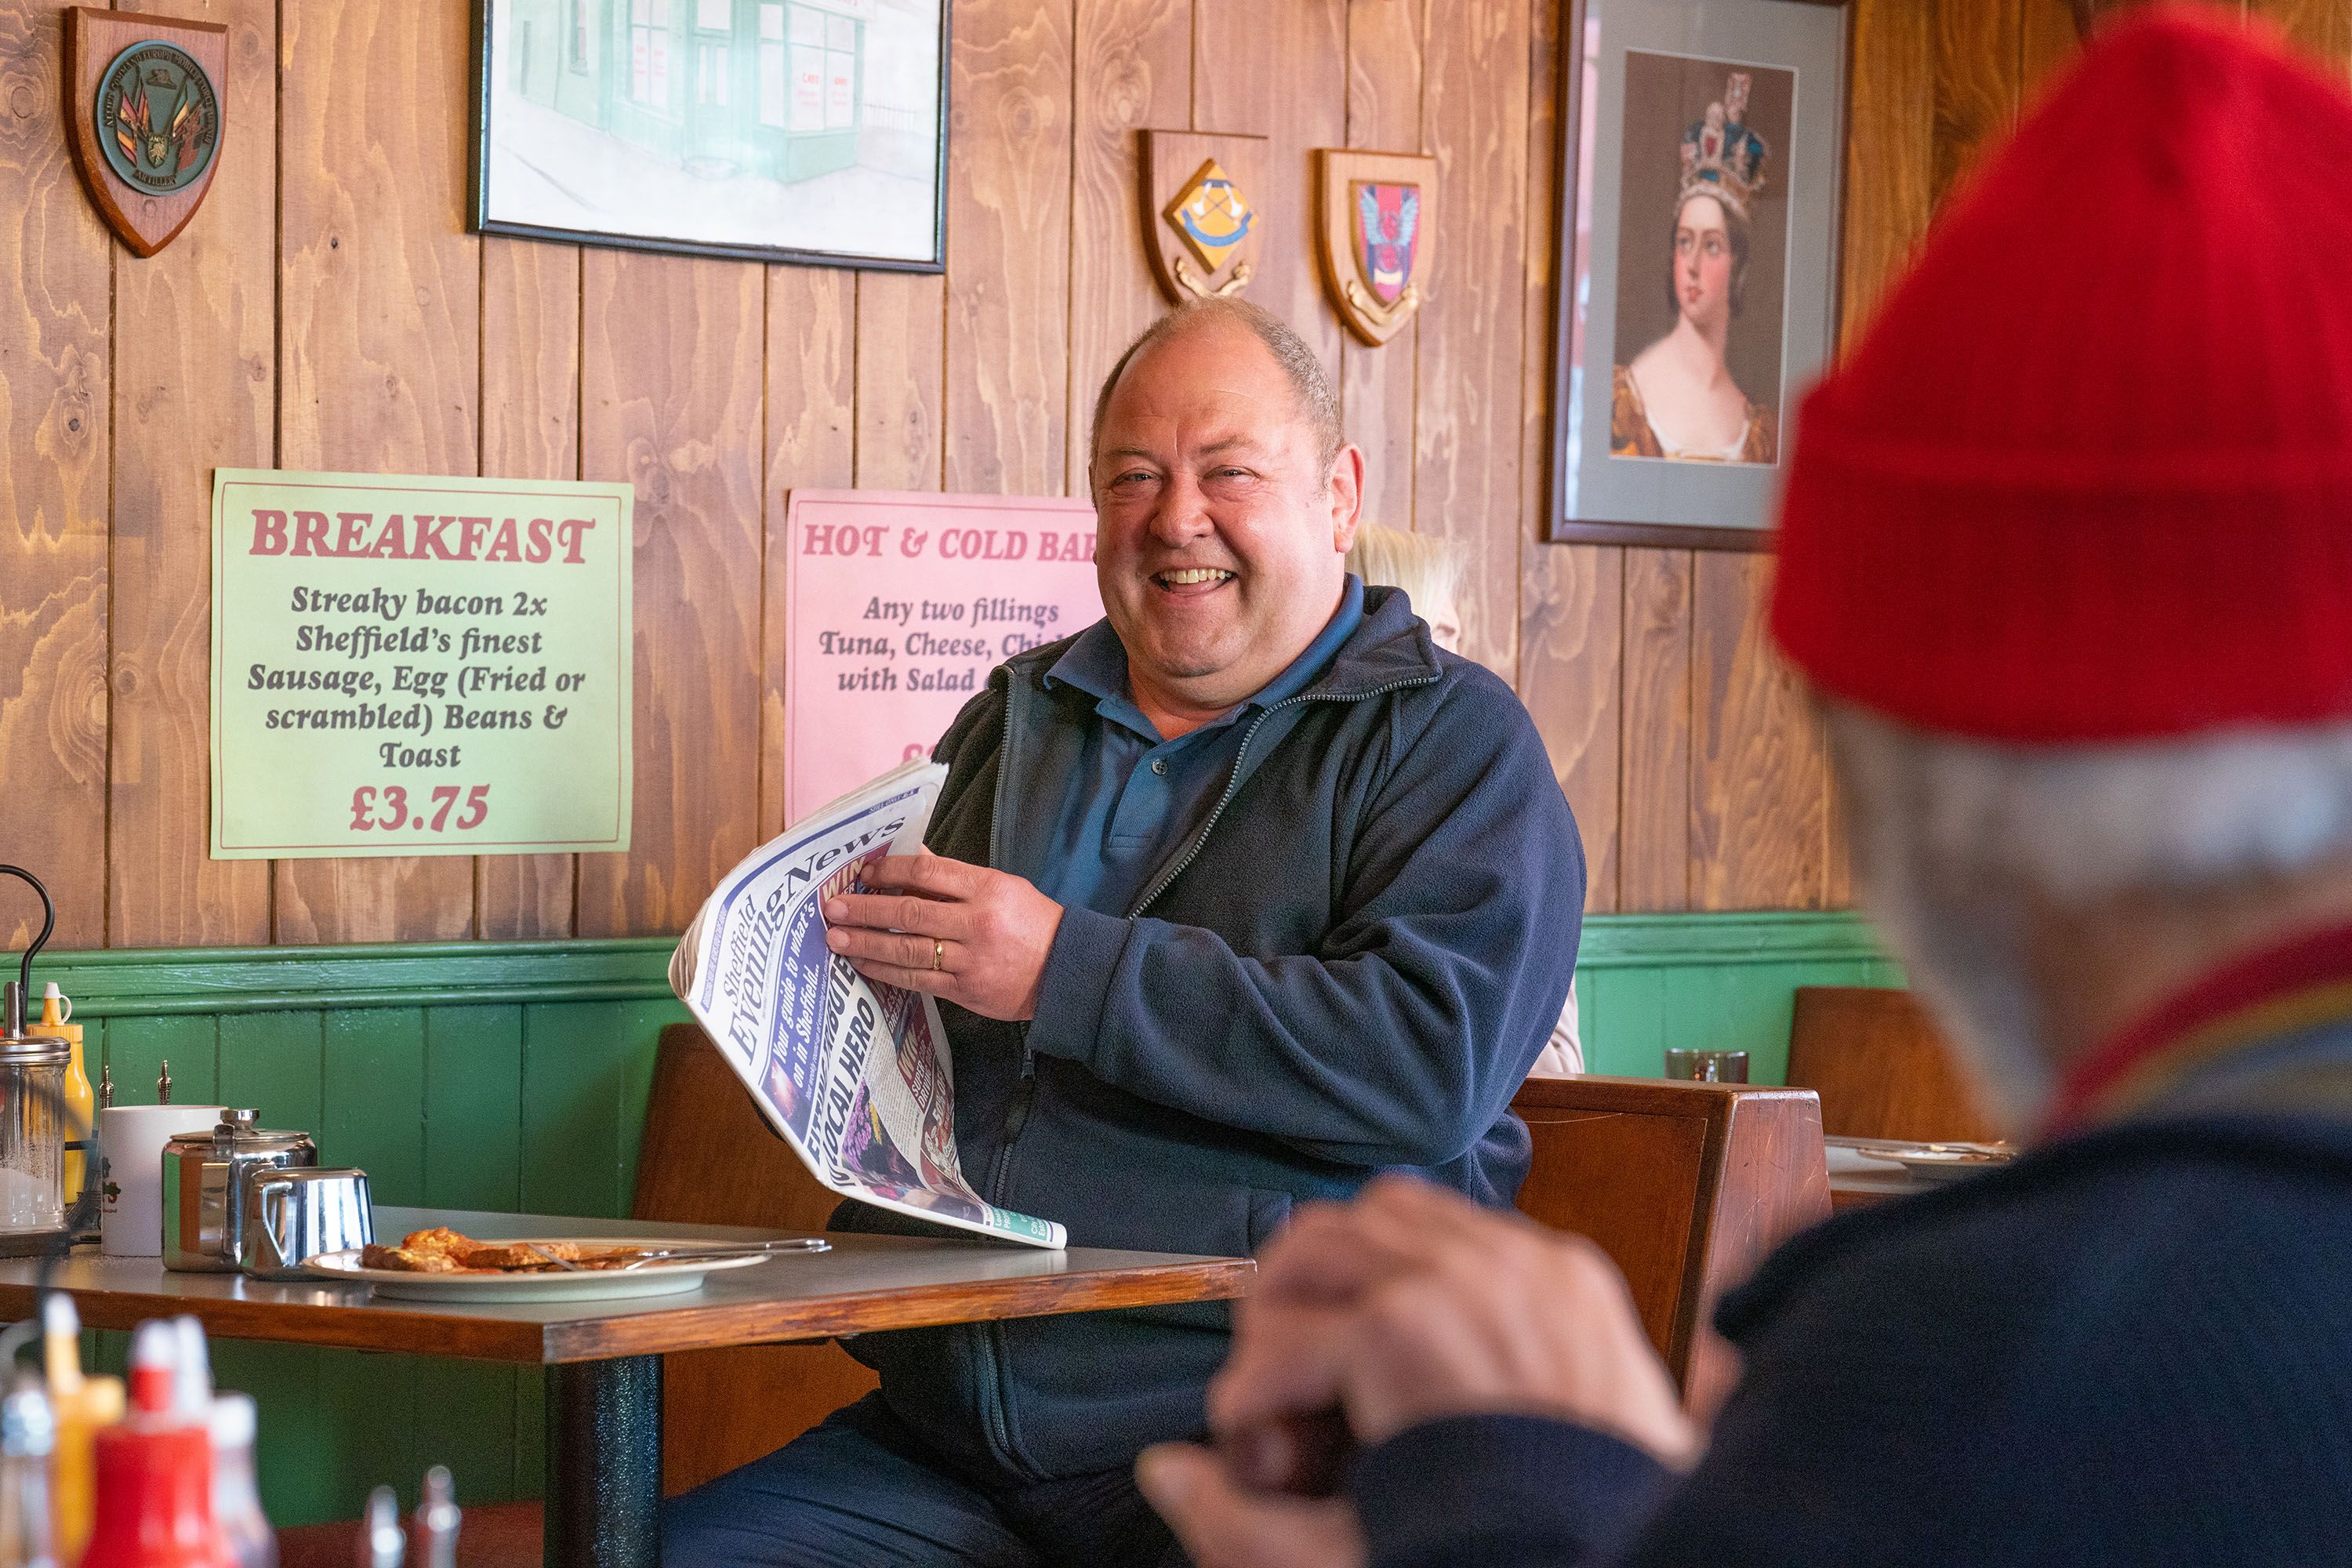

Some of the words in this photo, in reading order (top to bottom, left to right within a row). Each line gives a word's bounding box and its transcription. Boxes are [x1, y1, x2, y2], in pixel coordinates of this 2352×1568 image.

[249, 509, 596, 564] BREAKFAST
[803, 524, 889, 557] HOT
[900, 527, 928, 558] &
[939, 528, 1028, 560] COLD
[292, 586, 407, 621] Streaky
[416, 588, 503, 615] bacon
[513, 592, 547, 615] 2x
[863, 597, 913, 626] Any
[921, 600, 964, 621] two
[971, 597, 1059, 630] fillings
[296, 625, 451, 659] Sheffield's
[459, 627, 542, 660] finest
[819, 631, 895, 660] Tuna,
[906, 632, 992, 661] Cheese,
[248, 664, 381, 698] Sausage,
[392, 666, 448, 699] Egg
[458, 666, 546, 699] (Fried
[556, 673, 586, 691] or
[838, 666, 897, 691] with
[906, 668, 975, 691] Salad
[266, 703, 432, 736] scrambled)
[444, 705, 532, 729] Beans
[543, 705, 568, 729] &
[379, 742, 460, 768] Toast
[350, 784, 490, 833] £3.75
[790, 902, 816, 958] what's
[724, 894, 757, 1007] Sheffield
[785, 956, 799, 978] to
[781, 977, 797, 1029] guide
[823, 953, 855, 1063] TRIBUTE
[772, 1022, 789, 1064] Your
[793, 1042, 808, 1065] in
[793, 1062, 805, 1088] on
[822, 1075, 854, 1167] LOCAL
[839, 996, 874, 1086] HERO
[911, 1059, 925, 1098] SUPER
